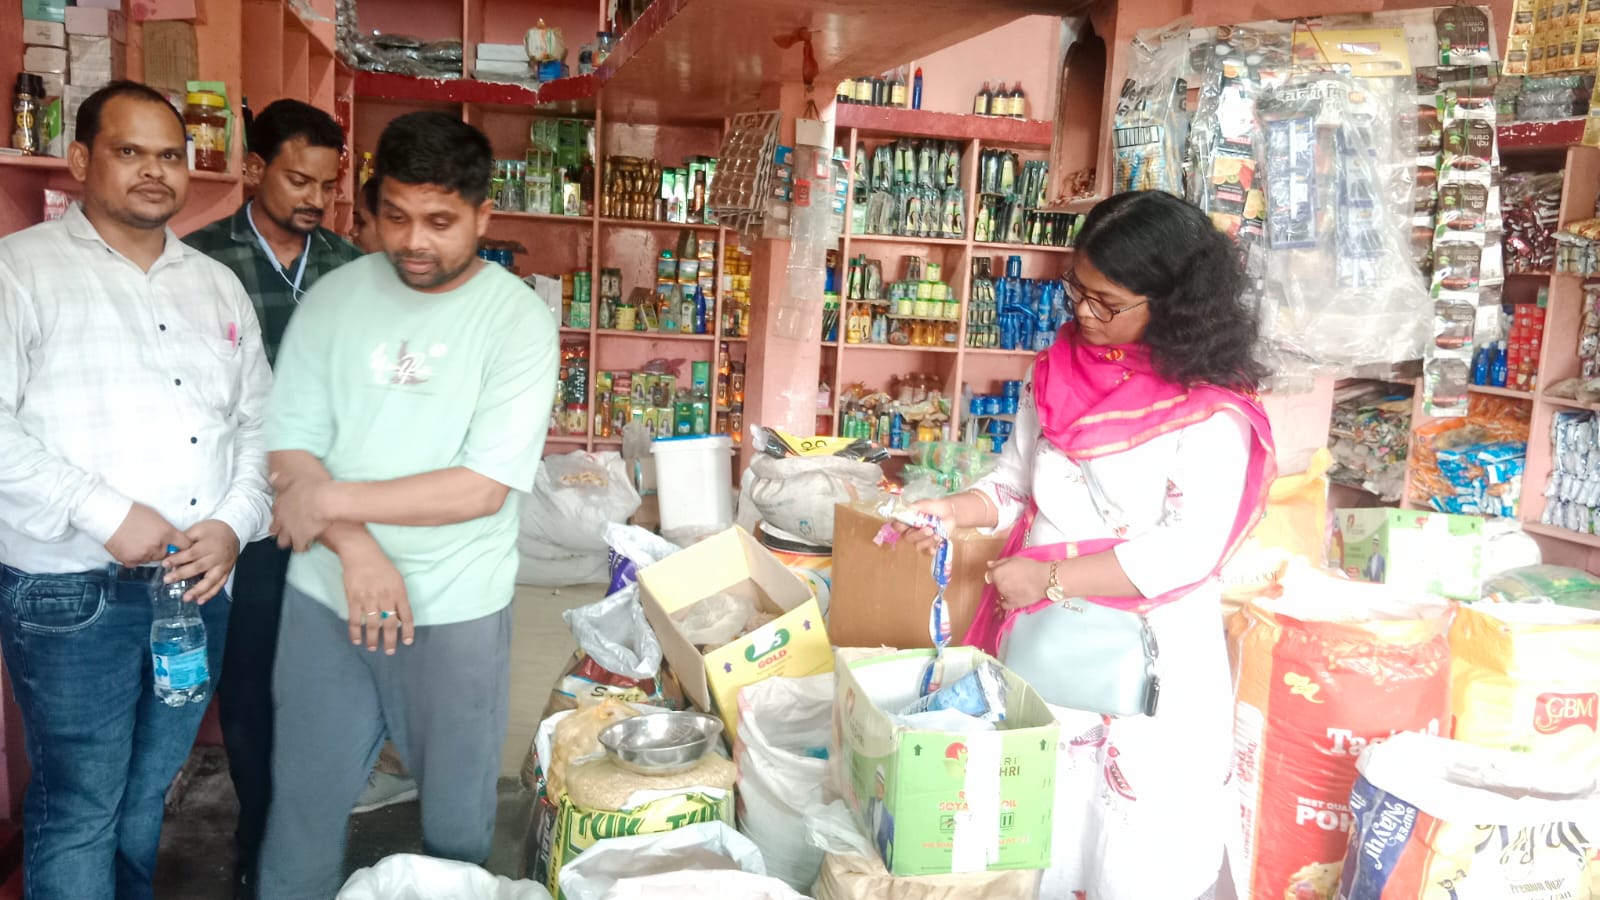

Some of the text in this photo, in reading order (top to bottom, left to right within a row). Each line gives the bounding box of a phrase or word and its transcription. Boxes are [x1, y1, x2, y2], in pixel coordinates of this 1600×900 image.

[757, 649, 788, 669] GOLD
[999, 765, 1021, 777] HRI
[938, 802, 969, 812] SOYA
[1327, 802, 1351, 812] QUA
[578, 811, 646, 841] TUK
[1296, 805, 1352, 832] POH
[1396, 806, 1416, 843] SUPER
